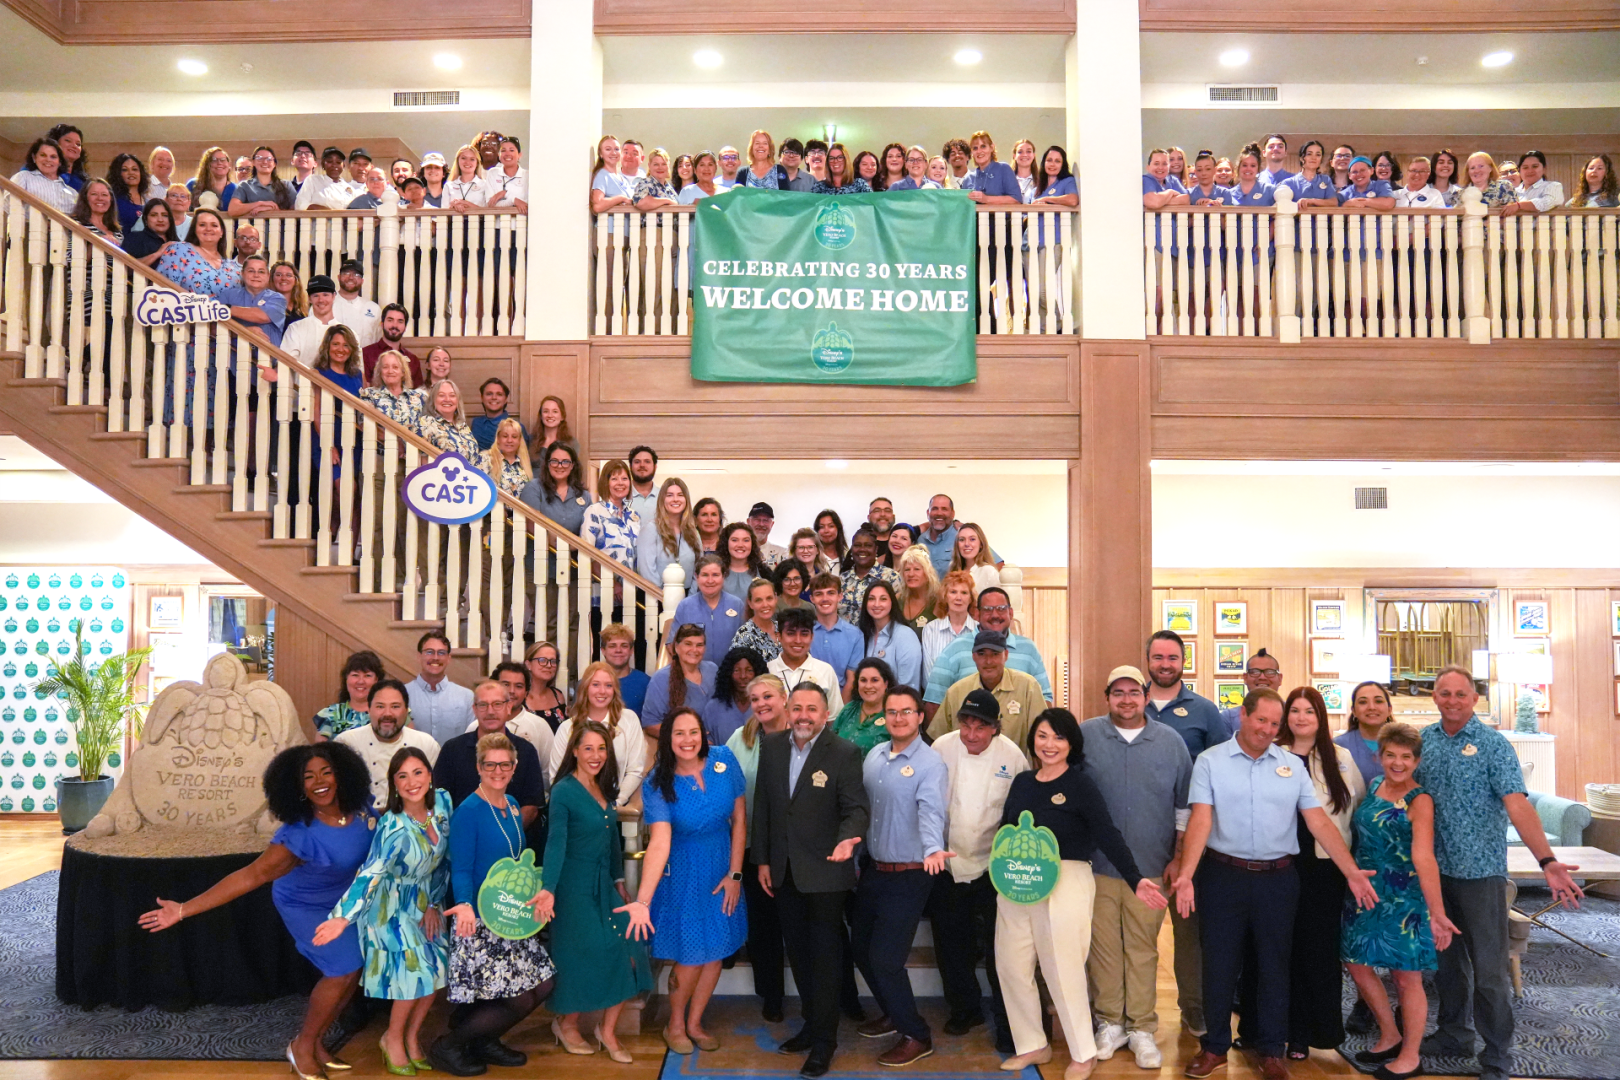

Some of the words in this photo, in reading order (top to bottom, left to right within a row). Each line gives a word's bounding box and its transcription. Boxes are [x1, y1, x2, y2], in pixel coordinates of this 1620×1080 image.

[703, 260, 860, 278] CELEBRATING
[865, 262, 890, 279] 30
[895, 263, 967, 280] YEARS
[181, 295, 207, 304] Disney
[700, 285, 864, 310] WELCOME
[870, 289, 969, 312] HOME
[147, 305, 195, 325] CAST
[198, 303, 229, 320] Life
[421, 483, 478, 504] CAST
[171, 745, 244, 773] Disney's
[156, 771, 205, 787] VERO
[210, 773, 256, 788] BEACH
[177, 789, 233, 800] RESORT
[157, 800, 180, 822] 30
[186, 802, 237, 826] YEARS
[1005, 859, 1041, 874] Disney's
[1004, 872, 1021, 880] VERO
[1022, 873, 1043, 882] BEACH
[1007, 890, 1017, 899] 30
[1018, 891, 1040, 901] YEARS
[492, 902, 510, 913] VERO
[510, 907, 532, 919] BEACH
[491, 920, 502, 930] 30
[502, 926, 525, 935] YEARS
